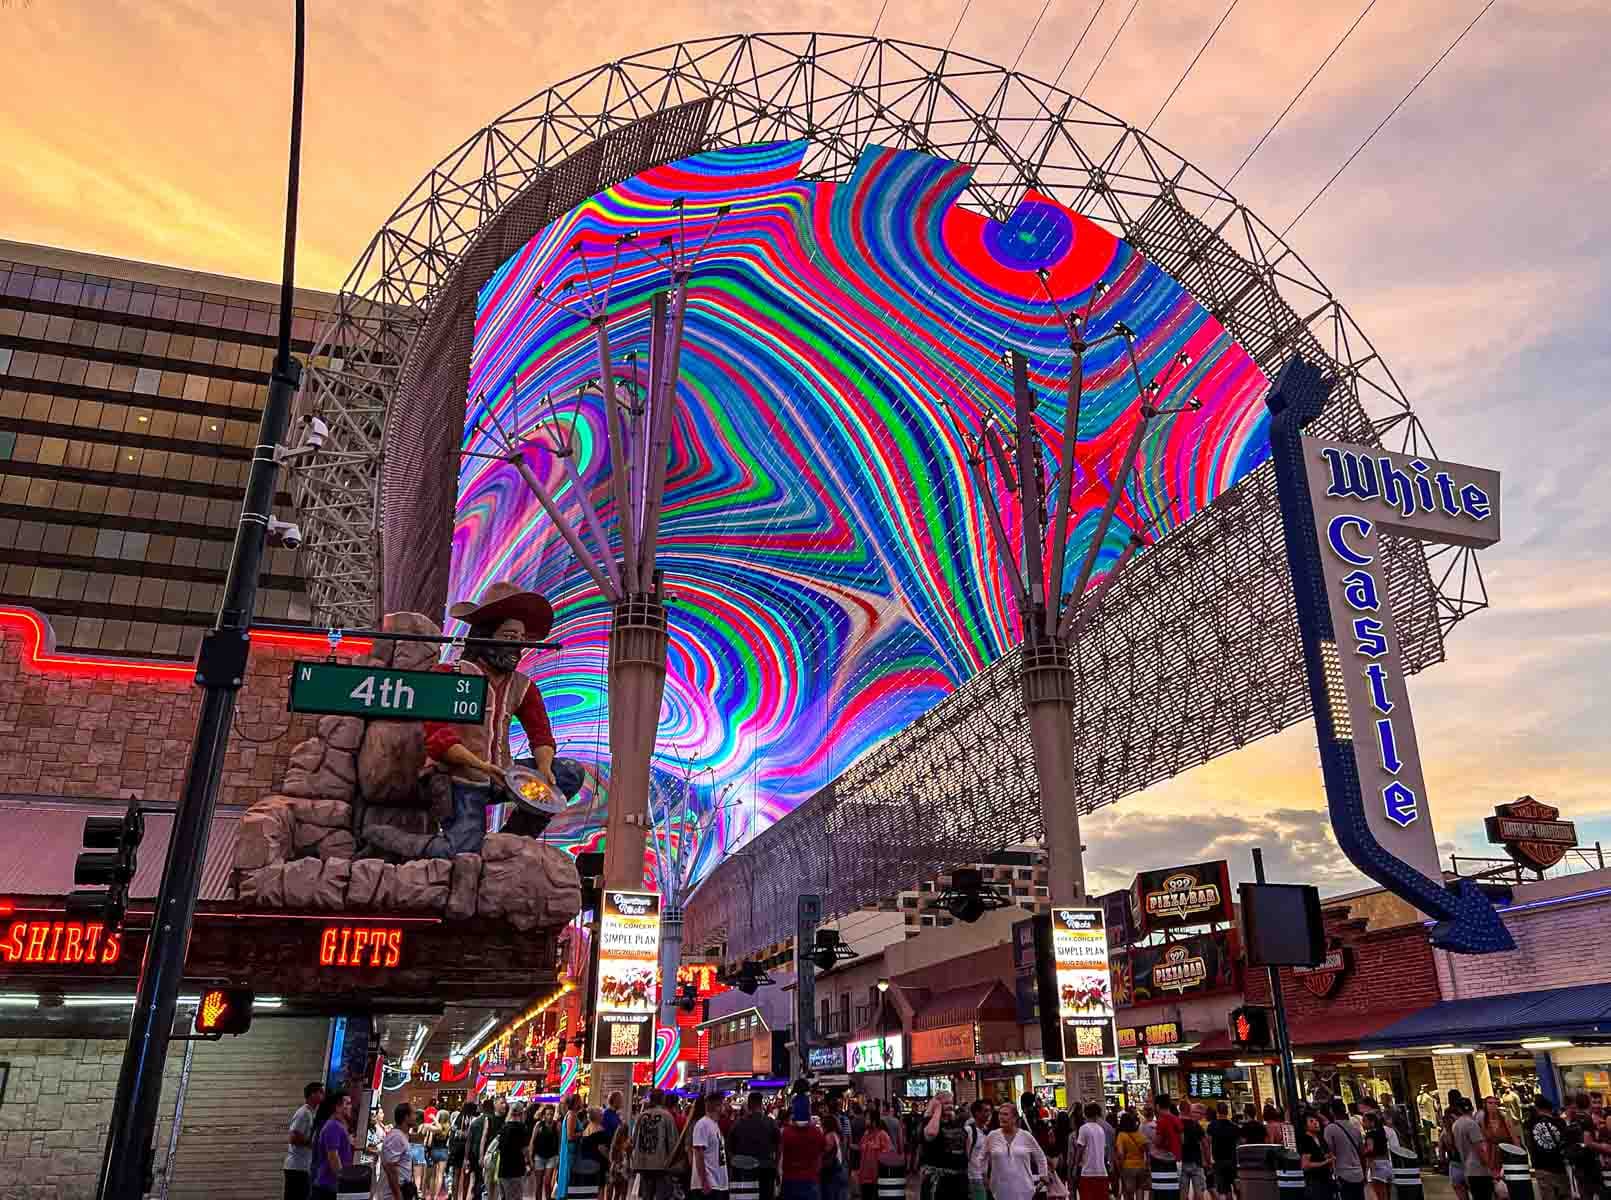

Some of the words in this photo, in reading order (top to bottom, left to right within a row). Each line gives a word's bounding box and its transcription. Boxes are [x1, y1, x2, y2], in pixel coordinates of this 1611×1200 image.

[1321, 447, 1490, 520] White
[1326, 514, 1417, 828] Castle
[301, 667, 312, 681] N
[350, 675, 415, 709] 4th
[456, 679, 471, 694] St
[453, 701, 479, 716] 100
[1149, 893, 1188, 909] PIZZA
[1188, 888, 1216, 904] BAR
[320, 927, 402, 966] GIFTS
[603, 933, 633, 945] SIMPLE
[635, 935, 656, 945] PLAN
[1057, 946, 1083, 956] SIMPLE
[1085, 946, 1105, 956] PLAN
[1155, 965, 1184, 982] PIZZA
[1184, 961, 1203, 978] BAR
